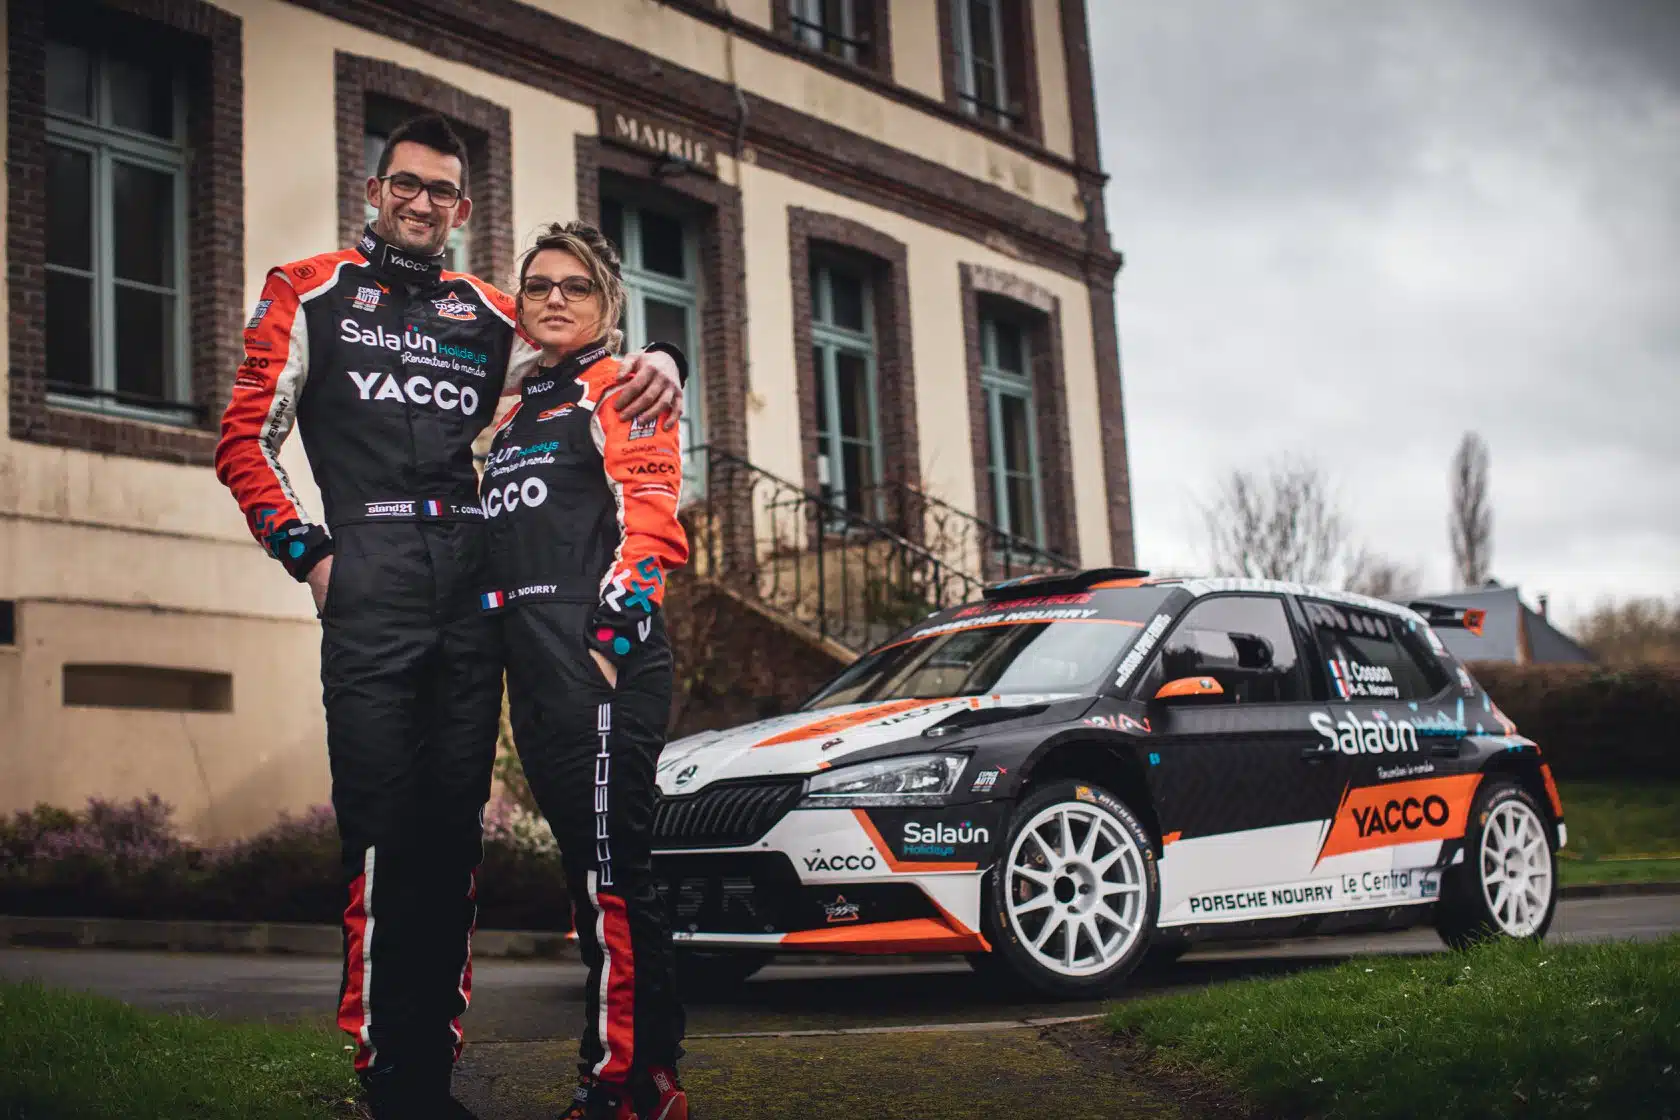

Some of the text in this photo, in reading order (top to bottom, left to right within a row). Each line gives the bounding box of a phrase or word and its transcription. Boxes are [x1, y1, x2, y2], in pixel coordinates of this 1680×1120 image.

[615, 113, 710, 167] MAIRIE
[390, 254, 430, 272] YACCO
[355, 292, 380, 304] AUTO
[435, 303, 477, 314] COSSON
[438, 343, 488, 365] Holidays
[347, 371, 479, 416] YACCO
[527, 380, 555, 395] YACCO
[518, 584, 557, 597] NOURRY
[594, 703, 614, 886] PORSCHE
[1351, 794, 1450, 838] YACCO
[803, 855, 876, 872] YACCO
[1189, 890, 1268, 913] PORSCHE
[1271, 885, 1334, 906] NOURRY
[1362, 868, 1413, 892] Central
